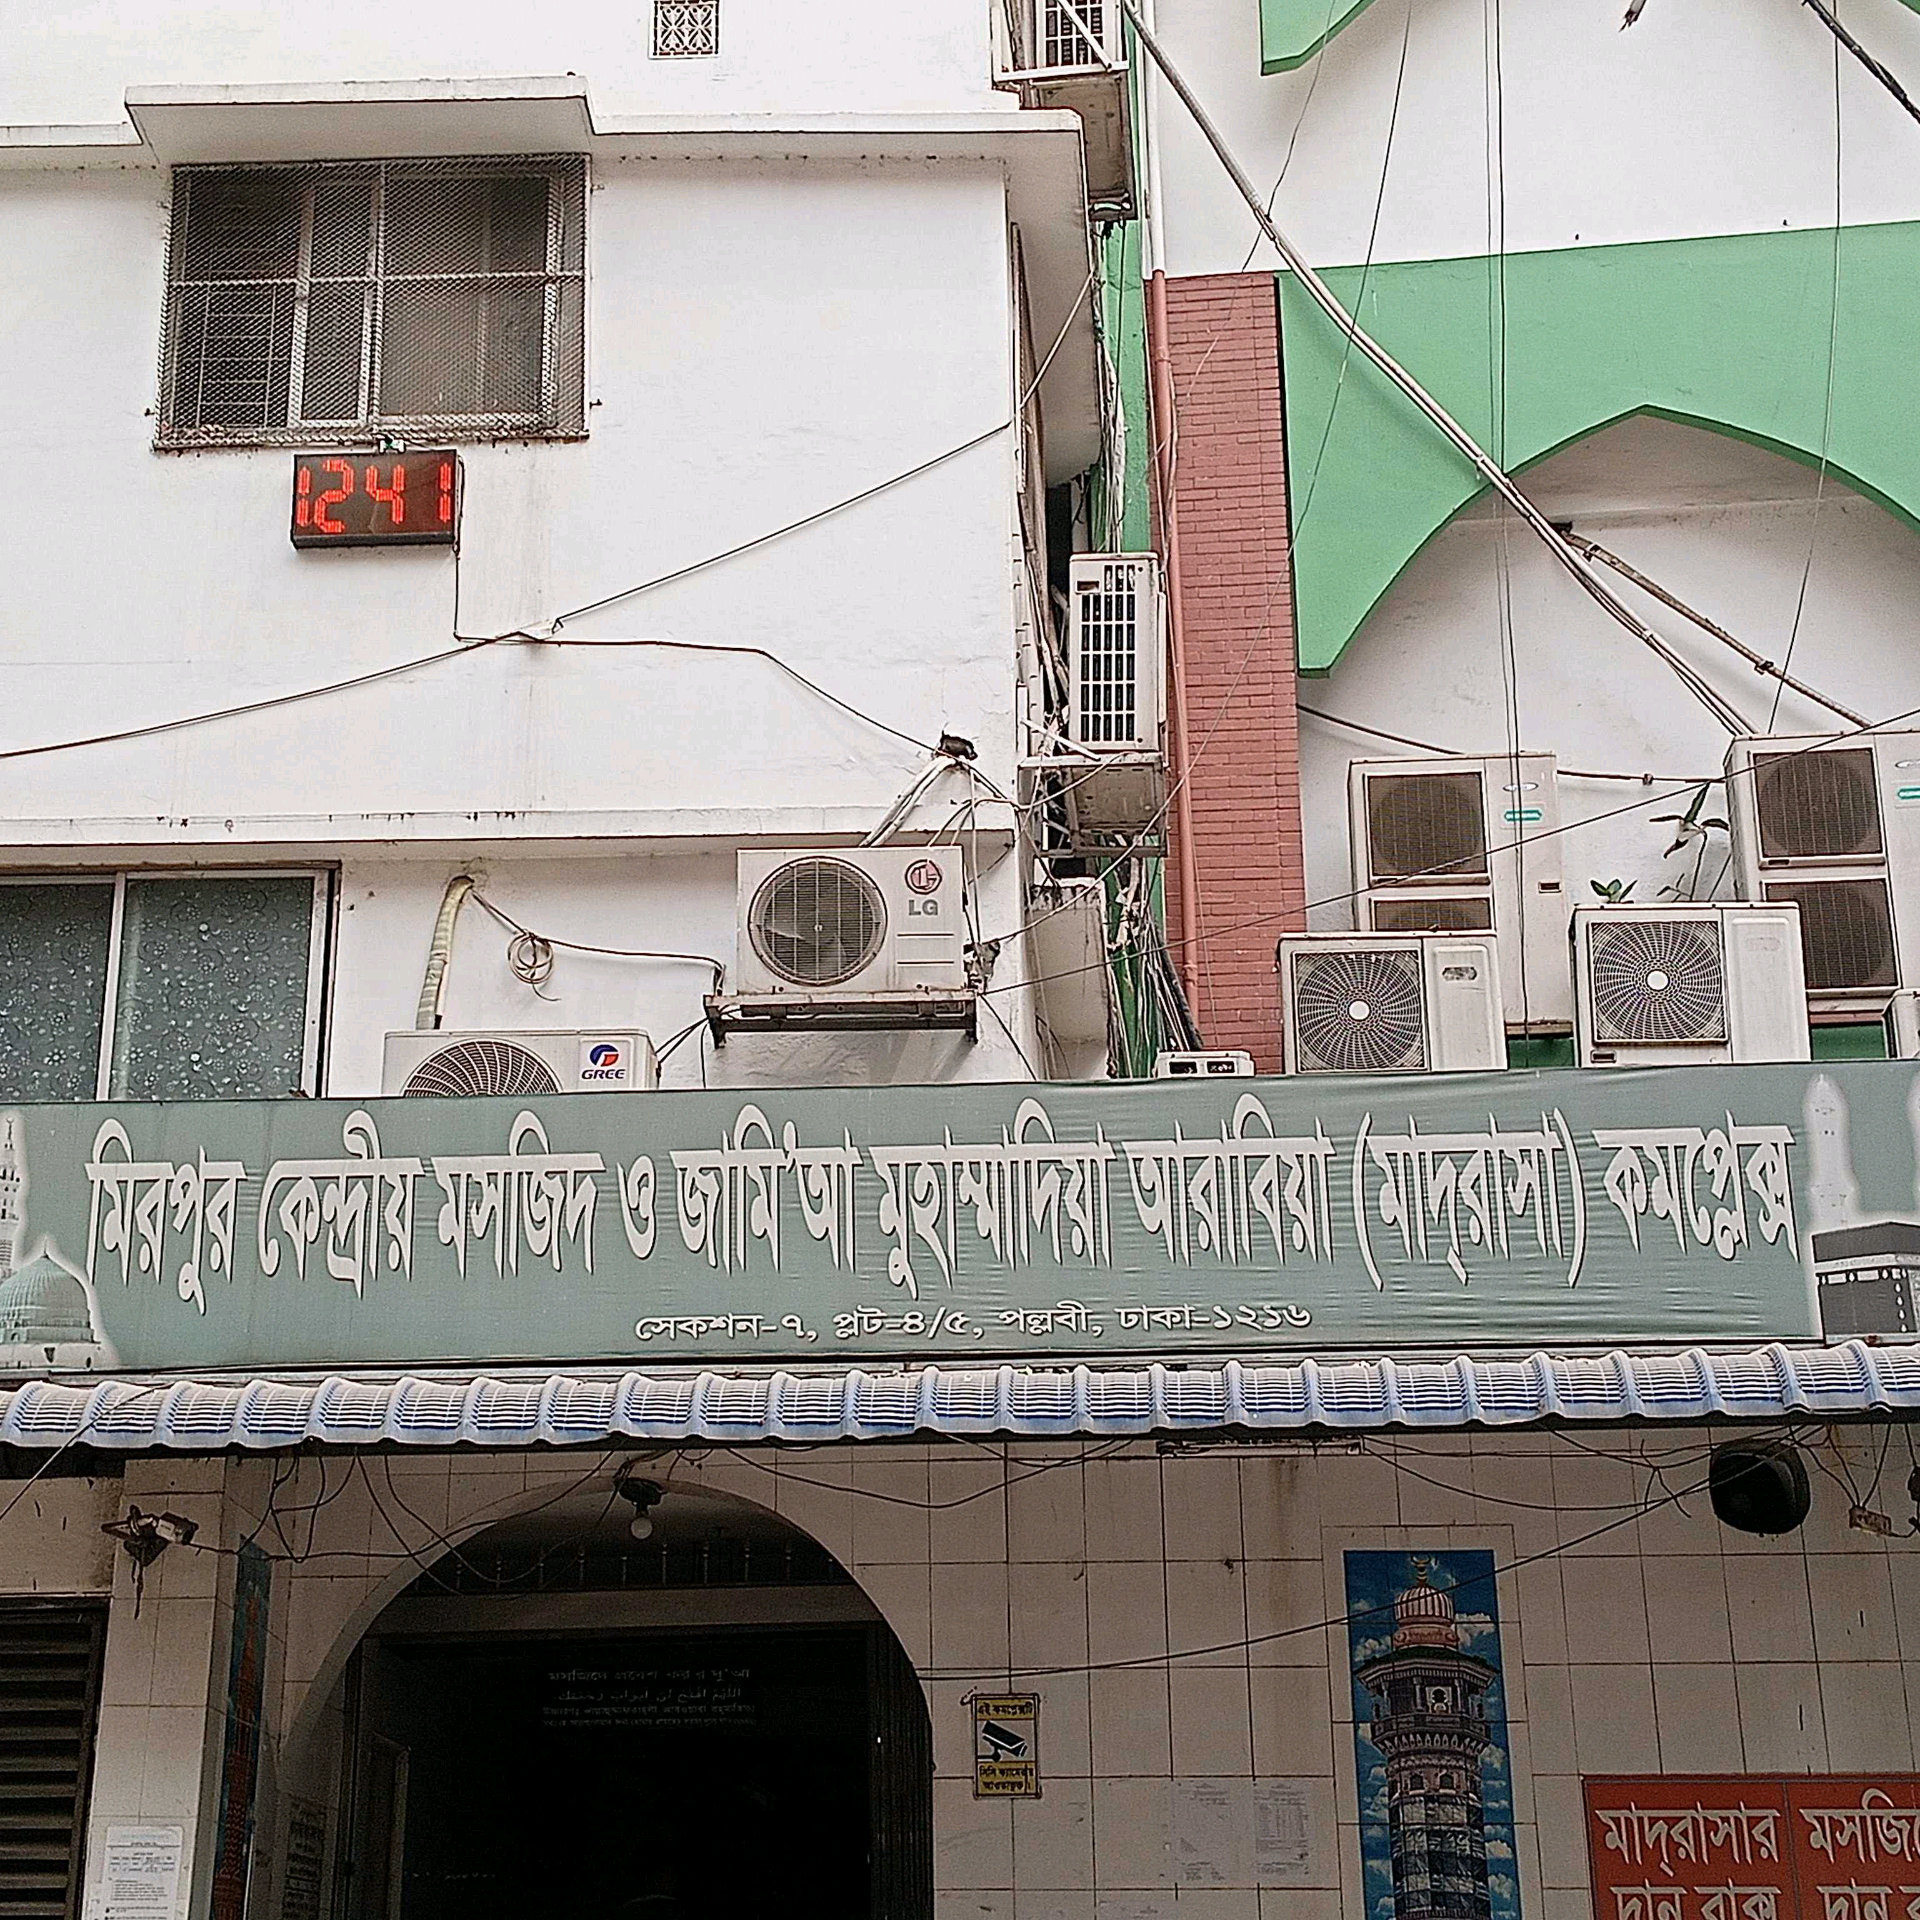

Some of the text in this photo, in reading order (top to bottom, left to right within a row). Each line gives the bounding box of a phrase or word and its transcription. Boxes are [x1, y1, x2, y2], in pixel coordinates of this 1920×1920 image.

[908, 899, 939, 916] LG
[581, 1068, 626, 1080] GREE
[85, 1118, 245, 1315] মিরপুর
[260, 1110, 426, 1299] কেন্দ্রীয়
[431, 1110, 606, 1280] মসজিদ
[618, 1155, 656, 1259] ও
[868, 1098, 1117, 1300] মুহাম্মাদিয়া
[1122, 1092, 1336, 1266] আরাবিয়া
[1591, 1109, 1801, 1262] কমপ্লেক্স
[1114, 1303, 1312, 1332] ঢাকা-১২১৬
